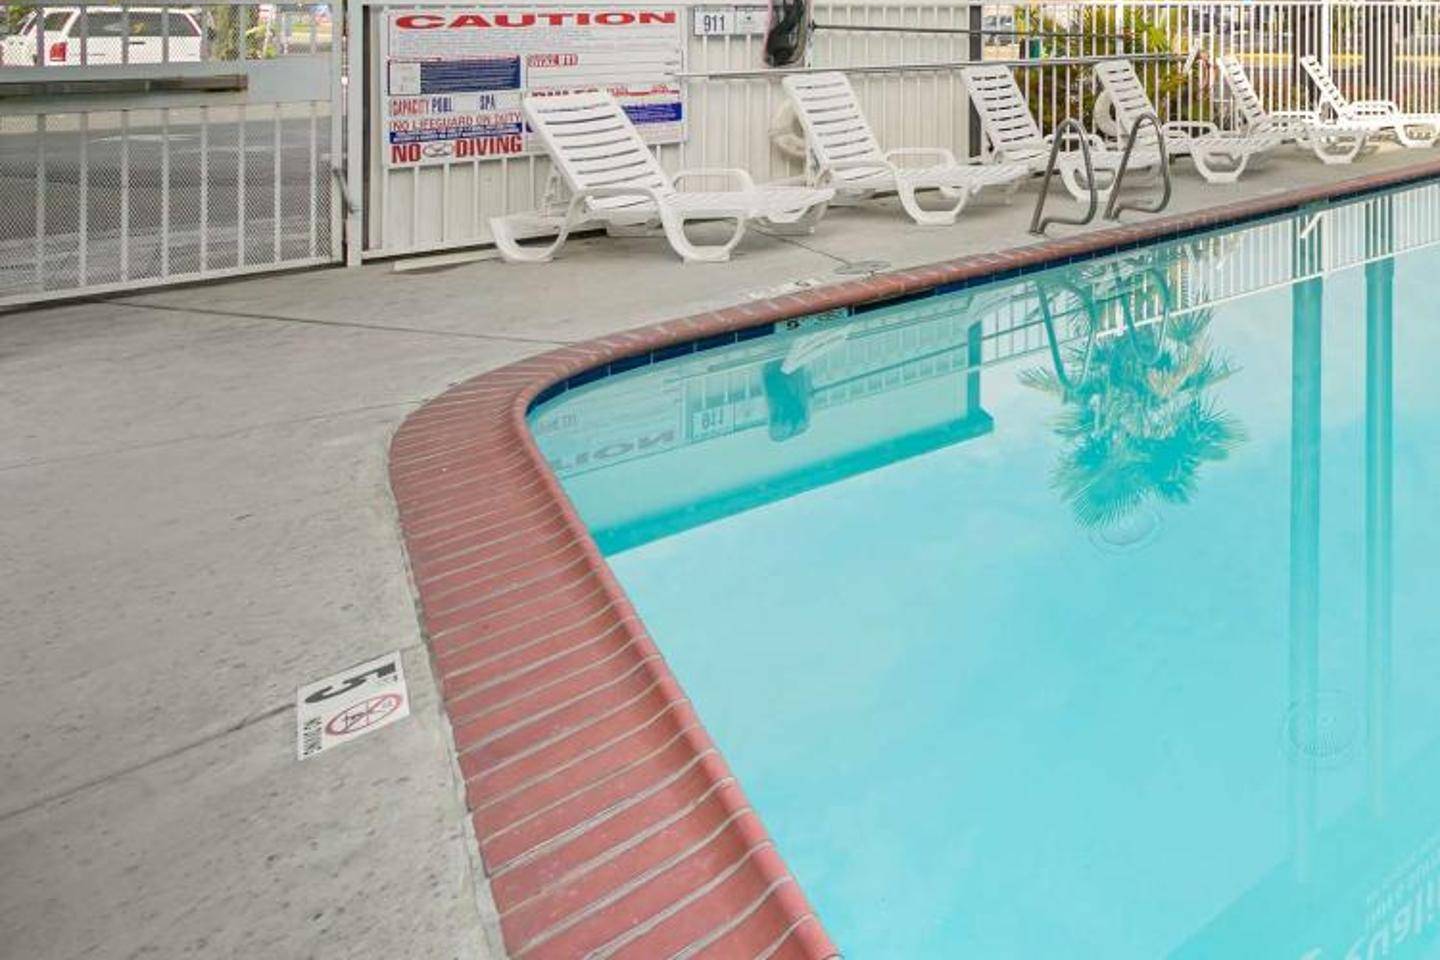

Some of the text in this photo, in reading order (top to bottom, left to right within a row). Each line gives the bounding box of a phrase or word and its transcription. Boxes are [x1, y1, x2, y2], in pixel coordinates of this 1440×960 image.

[396, 13, 676, 29] CAUTION
[704, 15, 725, 32] 911
[480, 94, 495, 110] SPA
[391, 120, 410, 132] NO
[412, 116, 474, 130] LIFEGUARD
[392, 136, 522, 163] NO DIVING
[305, 662, 397, 704] 5
